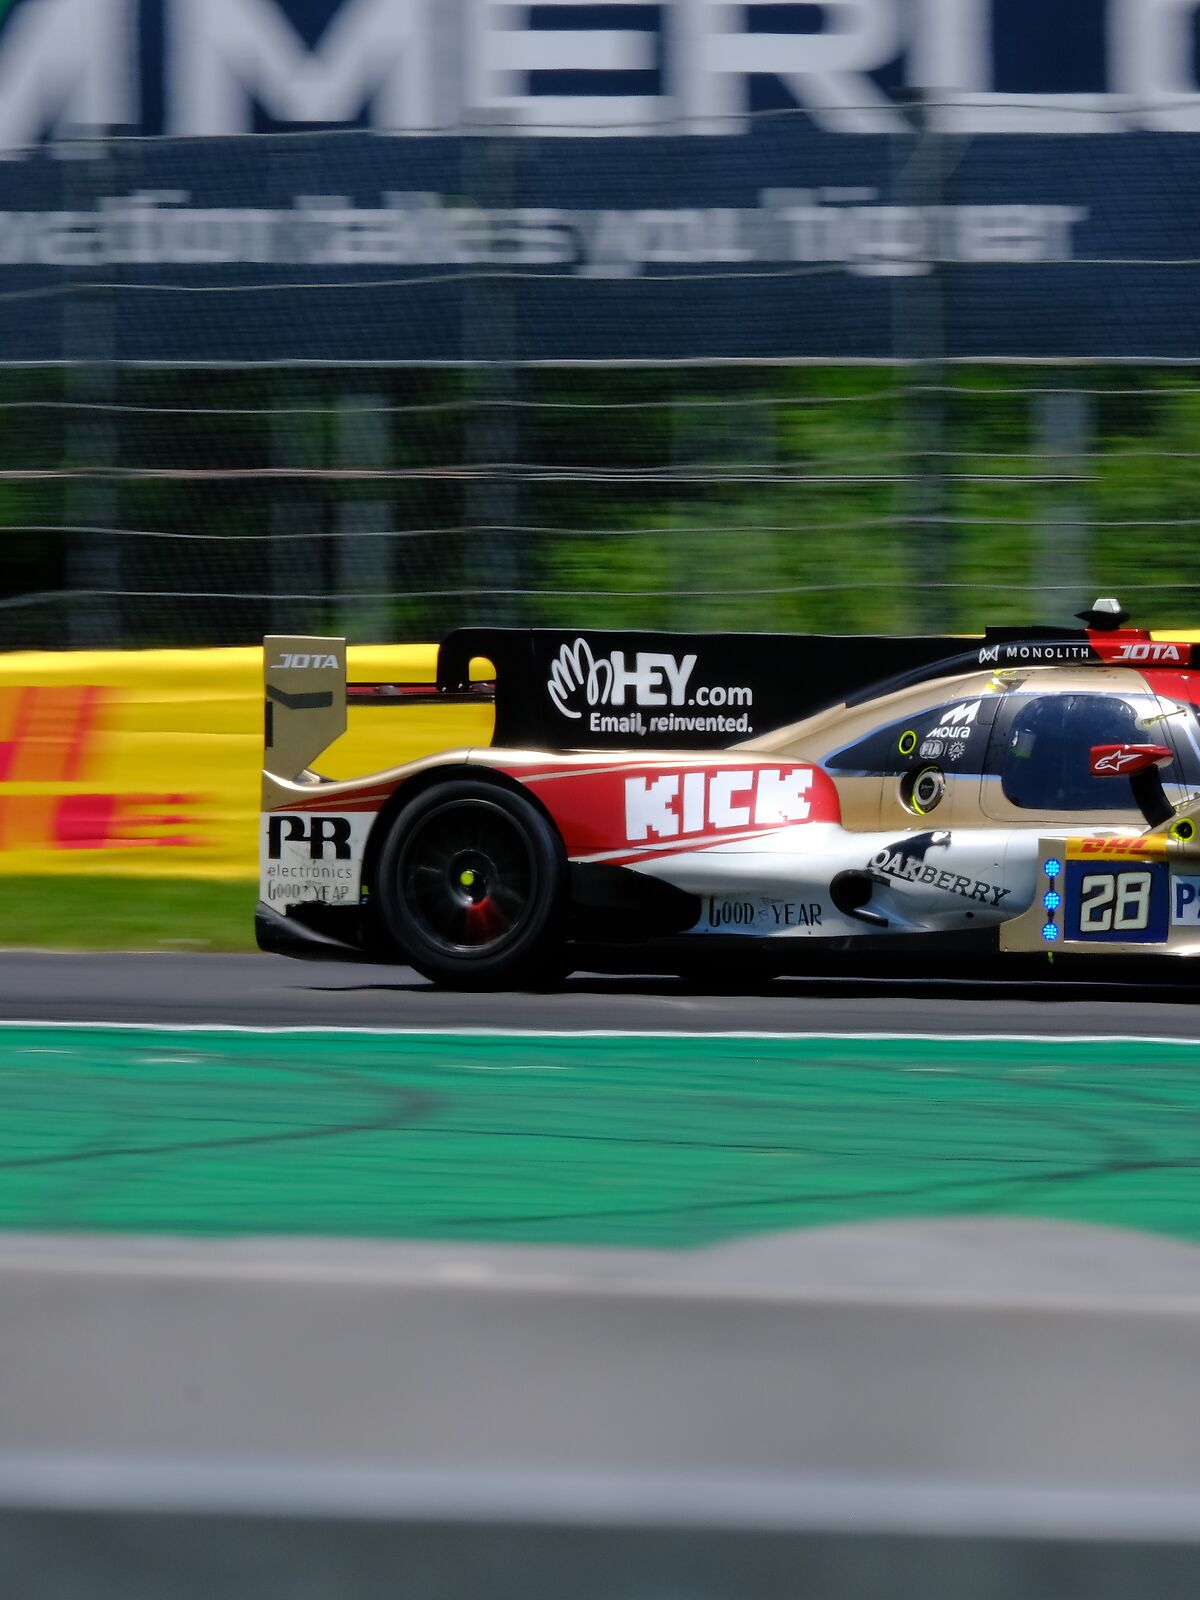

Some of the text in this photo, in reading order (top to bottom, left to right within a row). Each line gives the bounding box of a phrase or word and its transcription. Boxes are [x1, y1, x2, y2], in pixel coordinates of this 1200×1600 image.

[270, 653, 339, 669] JOTA
[1006, 647, 1089, 659] MONOLITH
[1111, 644, 1180, 660] JOTA
[610, 650, 753, 706] HEY.com
[590, 712, 753, 736] Email, reinvented.
[625, 769, 813, 841] KICK
[268, 815, 352, 859] PR
[1080, 837, 1160, 856] DHL
[268, 864, 352, 878] electronics
[869, 849, 1012, 906] OAKBERRY
[709, 896, 823, 928] GOOD YEAR
[1079, 871, 1152, 932] 28
